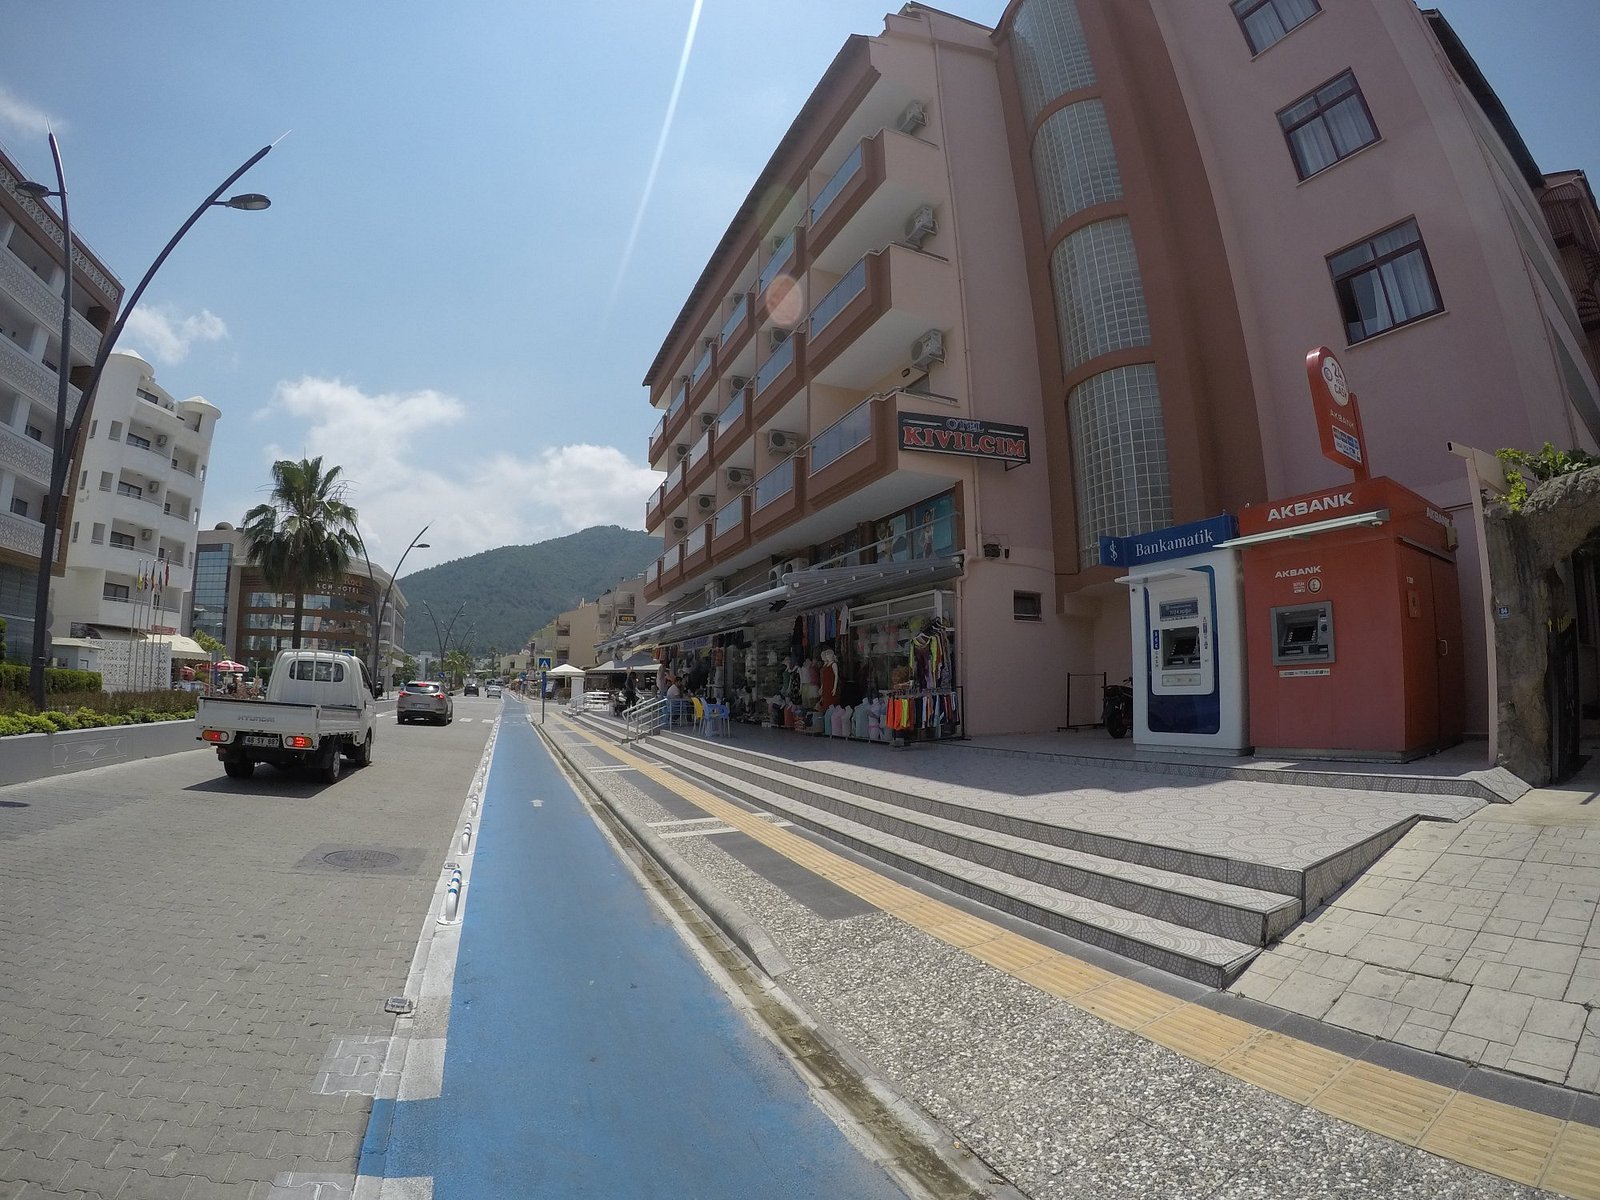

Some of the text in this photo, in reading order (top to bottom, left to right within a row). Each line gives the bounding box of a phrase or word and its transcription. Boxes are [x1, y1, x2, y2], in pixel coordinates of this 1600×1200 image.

[945, 418, 985, 433] OTEL
[903, 426, 1027, 457] KIVILCIM
[1266, 491, 1355, 522] AKBANK
[1135, 529, 1214, 557] Bankamatik
[1275, 565, 1322, 579] AKBANK
